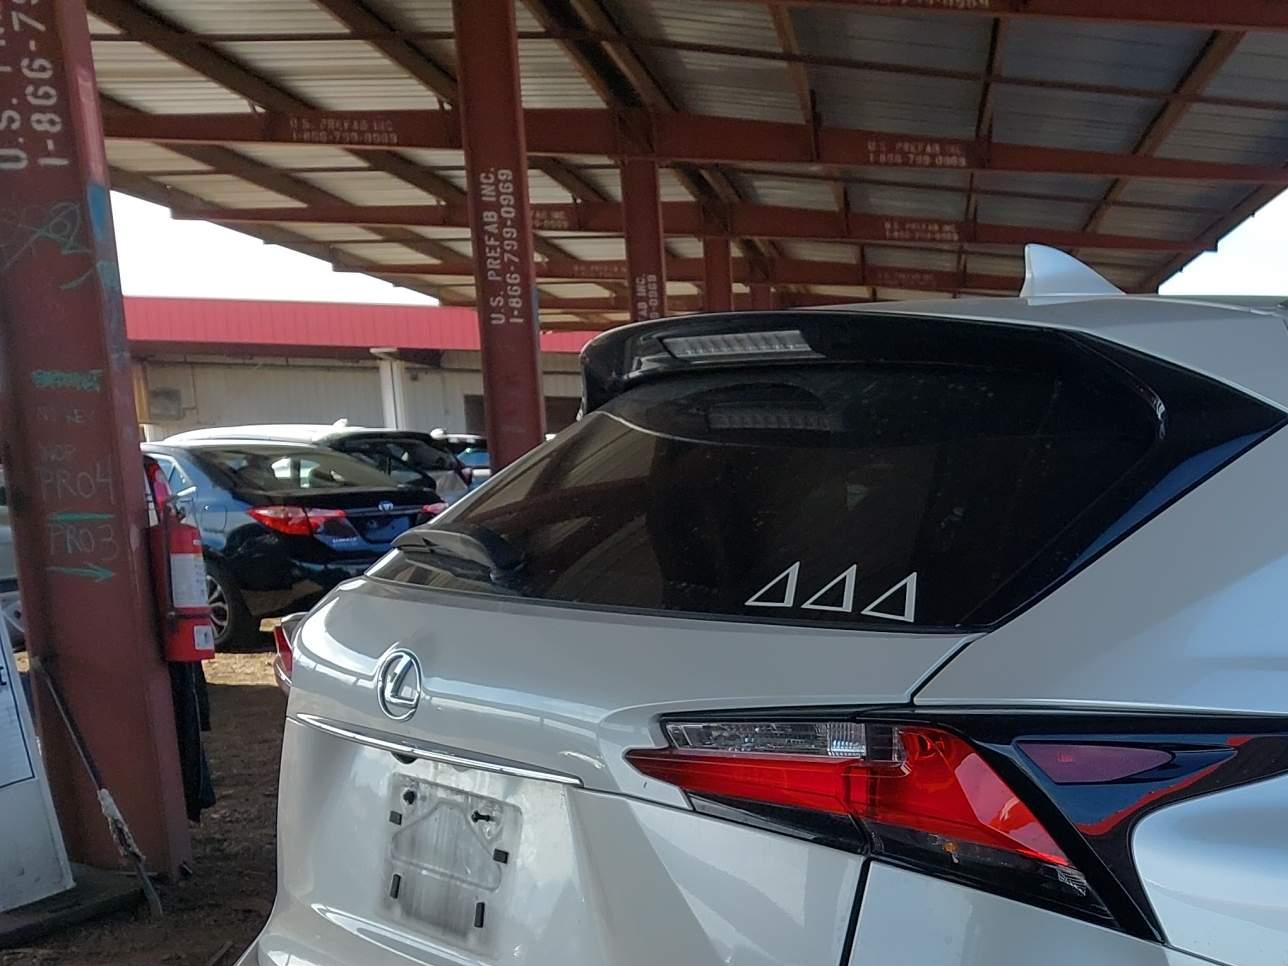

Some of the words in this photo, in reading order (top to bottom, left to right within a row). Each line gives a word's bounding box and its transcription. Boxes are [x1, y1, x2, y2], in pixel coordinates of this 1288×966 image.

[9, 0, 70, 167] 1-866-7
[480, 167, 497, 202] INC.
[482, 211, 502, 281] PREFAB
[497, 169, 524, 323] 1-866-799-0969
[489, 291, 506, 325] U.S.
